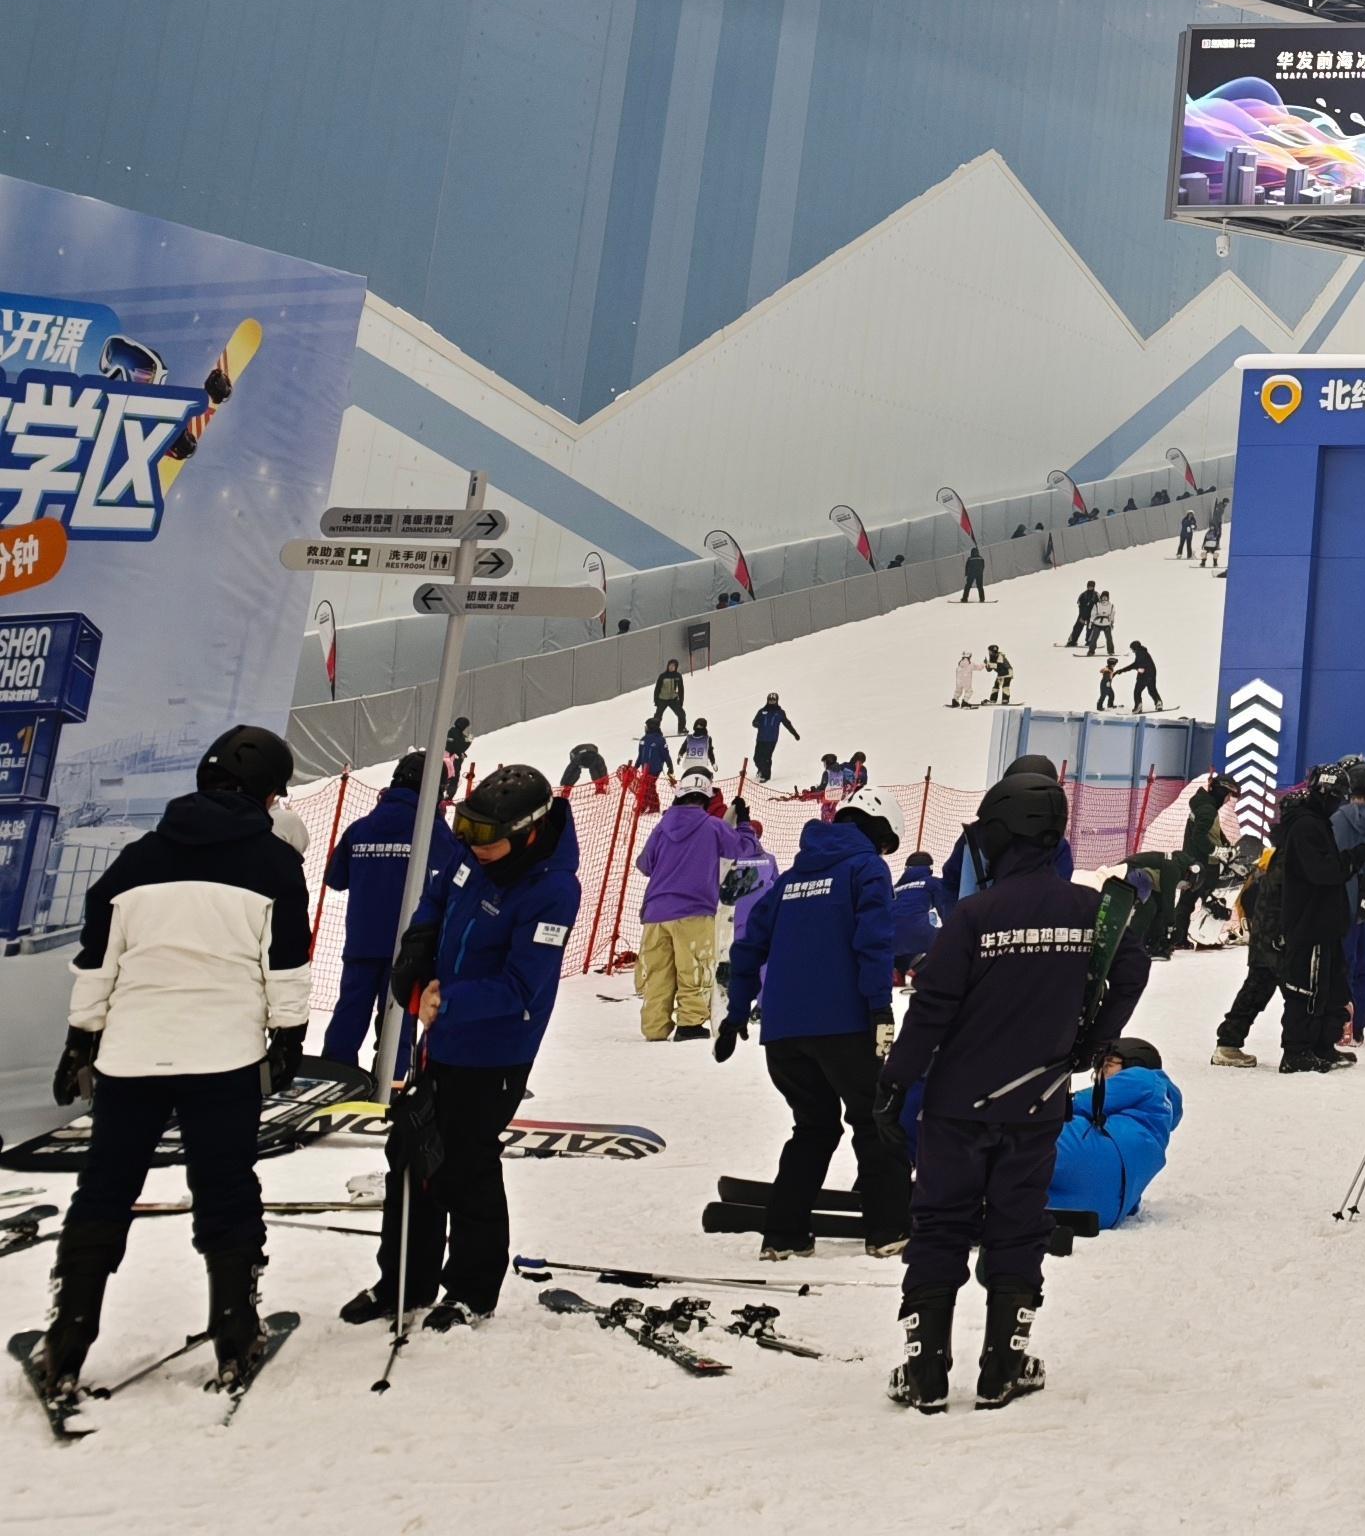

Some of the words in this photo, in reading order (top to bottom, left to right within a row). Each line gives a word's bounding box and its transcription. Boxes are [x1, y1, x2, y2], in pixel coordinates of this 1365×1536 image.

[0, 382, 200, 532] 学区
[341, 514, 393, 526] 中级滑雪道
[402, 514, 455, 526] 高级滑雪道
[306, 545, 346, 558] 救助室
[388, 550, 428, 562] 洗手间
[307, 558, 329, 566] FIRST
[385, 561, 426, 570] RESTROOM
[466, 591, 520, 603] 初级滑雪道
